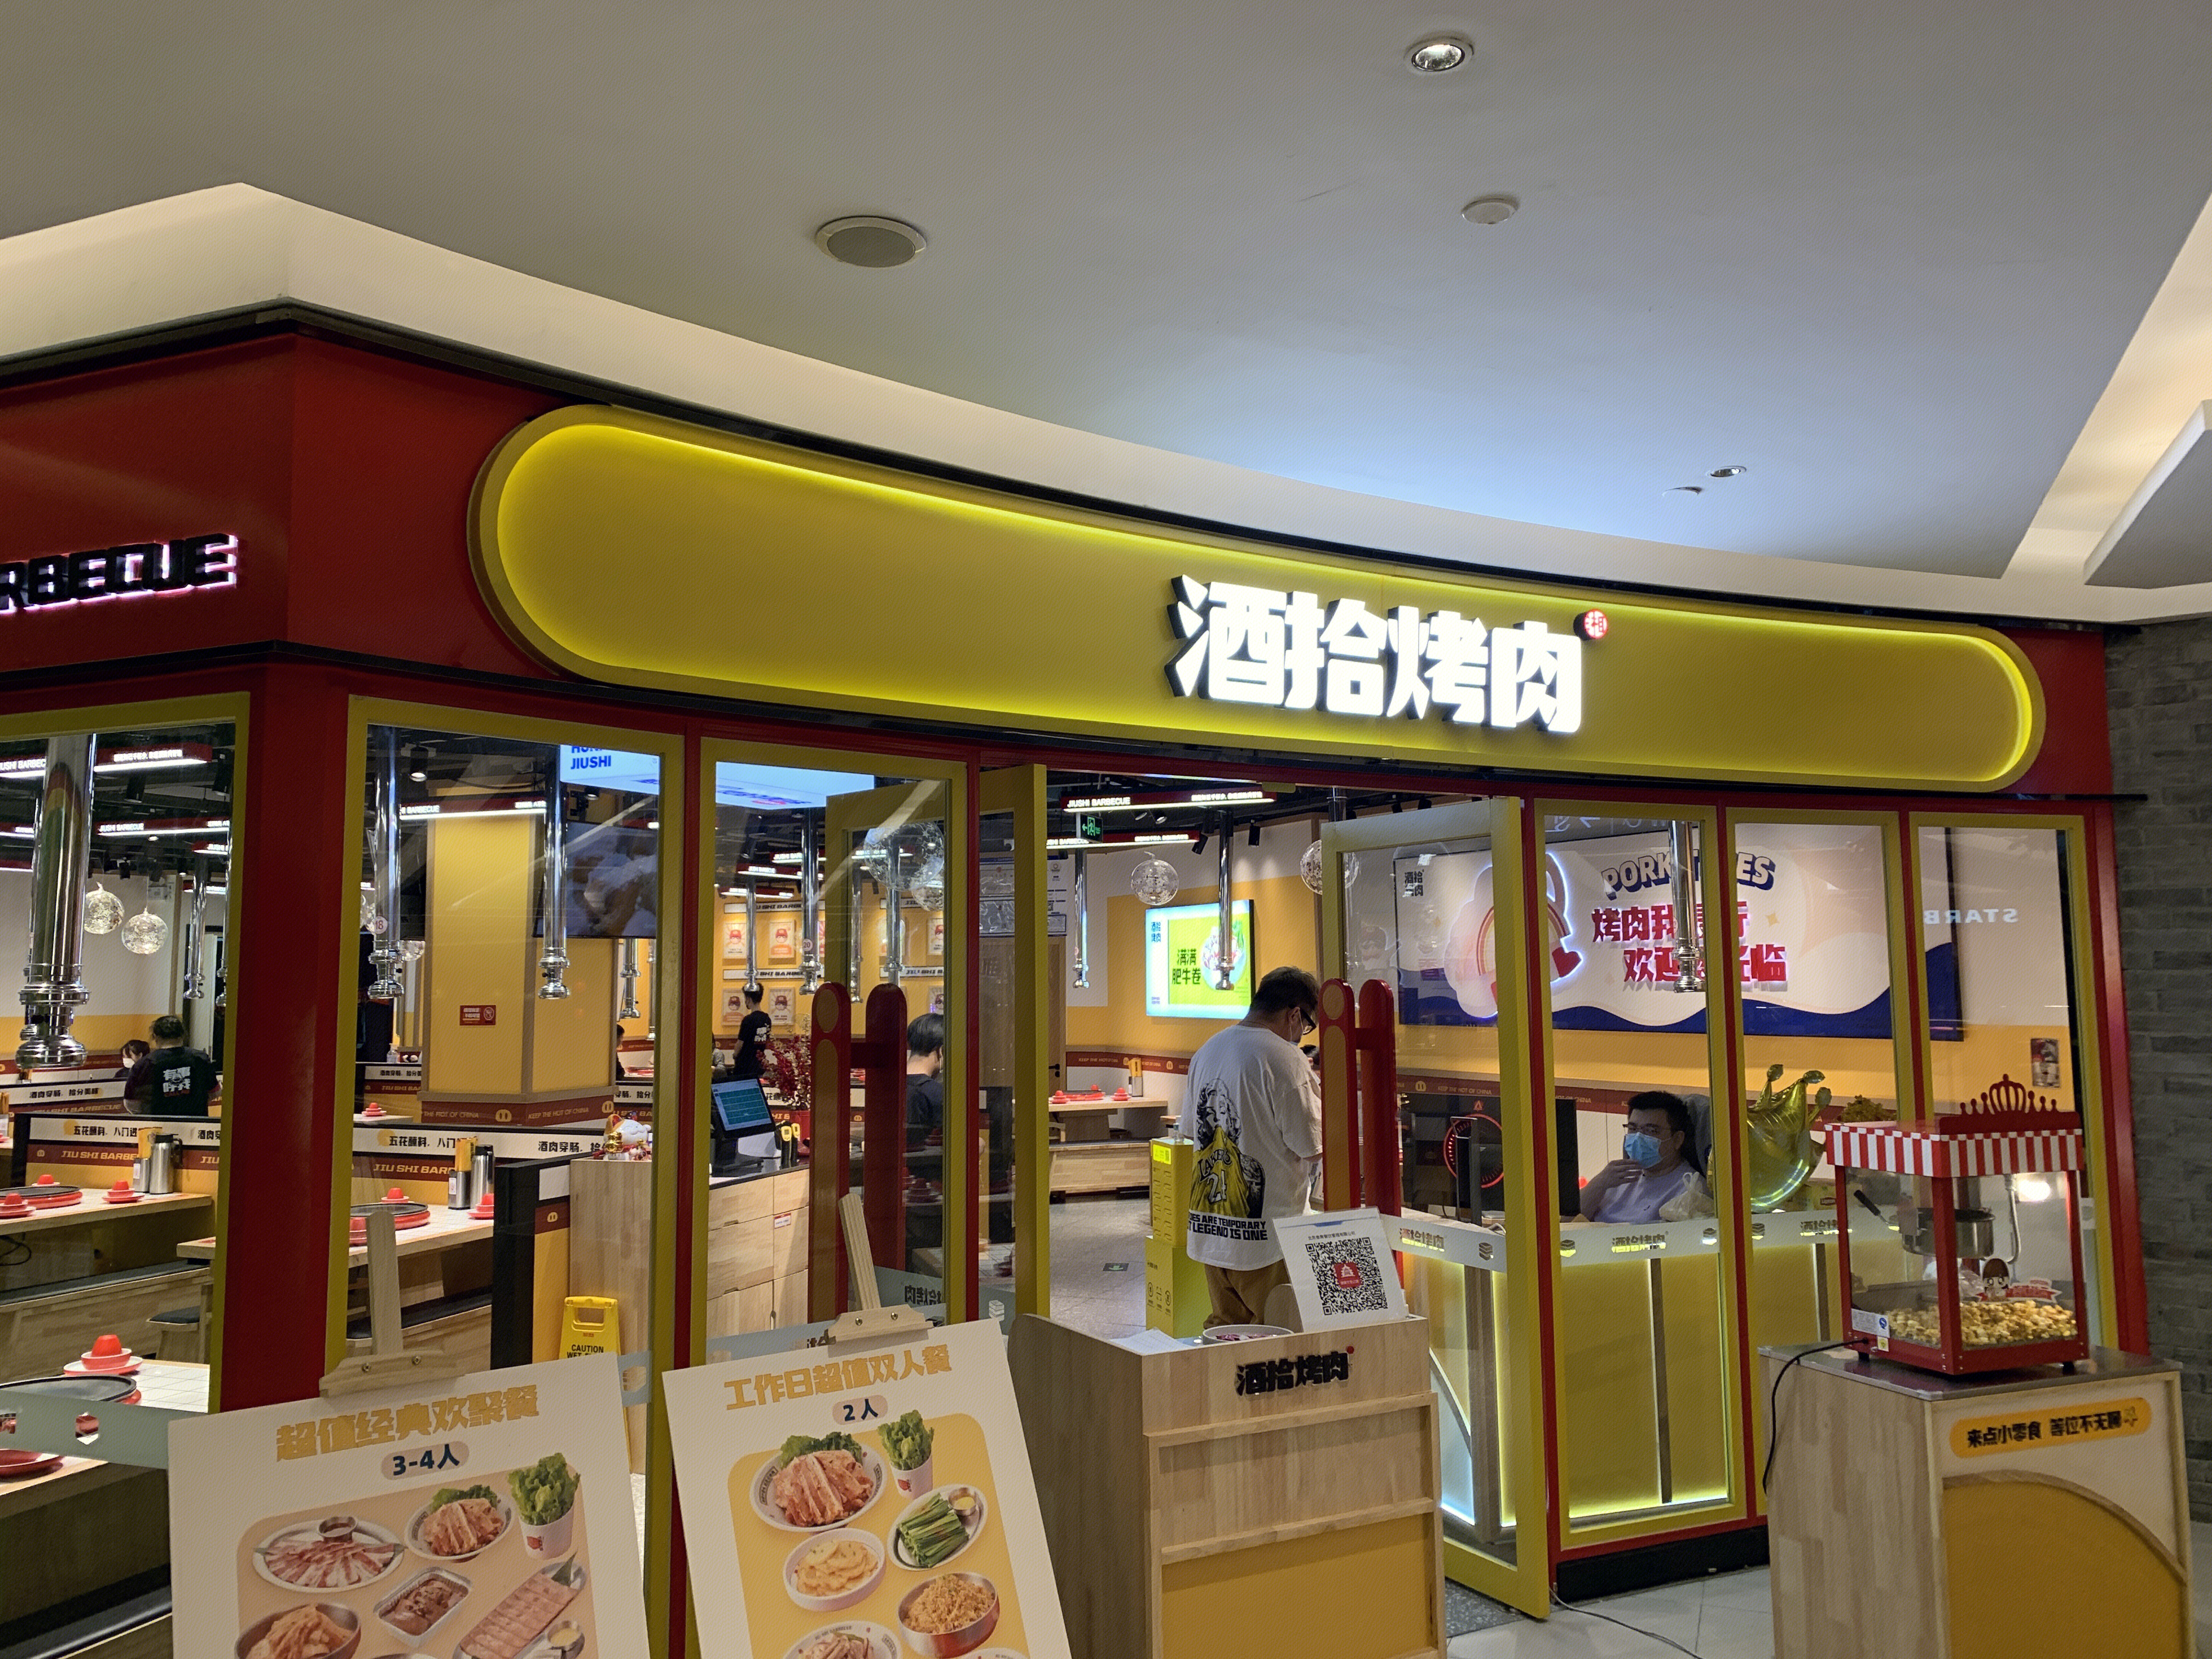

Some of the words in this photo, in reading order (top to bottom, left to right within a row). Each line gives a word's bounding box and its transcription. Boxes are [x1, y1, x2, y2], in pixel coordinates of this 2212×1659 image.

[1164, 574, 1582, 733] 酒拾烤肉
[571, 755, 612, 770] JIUSHI
[407, 805, 440, 814] BARBECUE
[1067, 799, 1090, 808] JIUSHI
[1092, 797, 1131, 806] BARBECUE
[99, 823, 116, 832] JIUSHI
[116, 822, 144, 832] BARBECUE
[375, 919, 383, 929] 18
[1177, 949, 1197, 966] 满满
[1623, 944, 1786, 983] 欢迎临
[1172, 967, 1201, 985] 肥牛卷
[70, 1103, 122, 1113] BARBECUE
[61, 1150, 79, 1159] JIU
[80, 1151, 99, 1159] SHI
[373, 1163, 395, 1171] JIU
[396, 1164, 419, 1173] SHI
[1201, 1215, 1217, 1225] ARE
[1218, 1217, 1266, 1230] TEMPORARY
[1192, 1222, 1229, 1238] LEGEND
[1230, 1228, 1242, 1240] IS
[1243, 1229, 1268, 1241] ONE
[571, 1344, 604, 1353] CAUTION
[724, 1344, 952, 1410] 工作日超值双人餐
[1236, 1350, 1349, 1397] 酒拾烤肉
[276, 1384, 540, 1462] 超值经典欢聚餐
[1967, 1420, 2042, 1448] 来点小零食
[2049, 1410, 2122, 1437] 等位不无聊
[392, 1443, 460, 1476] 3-4人
